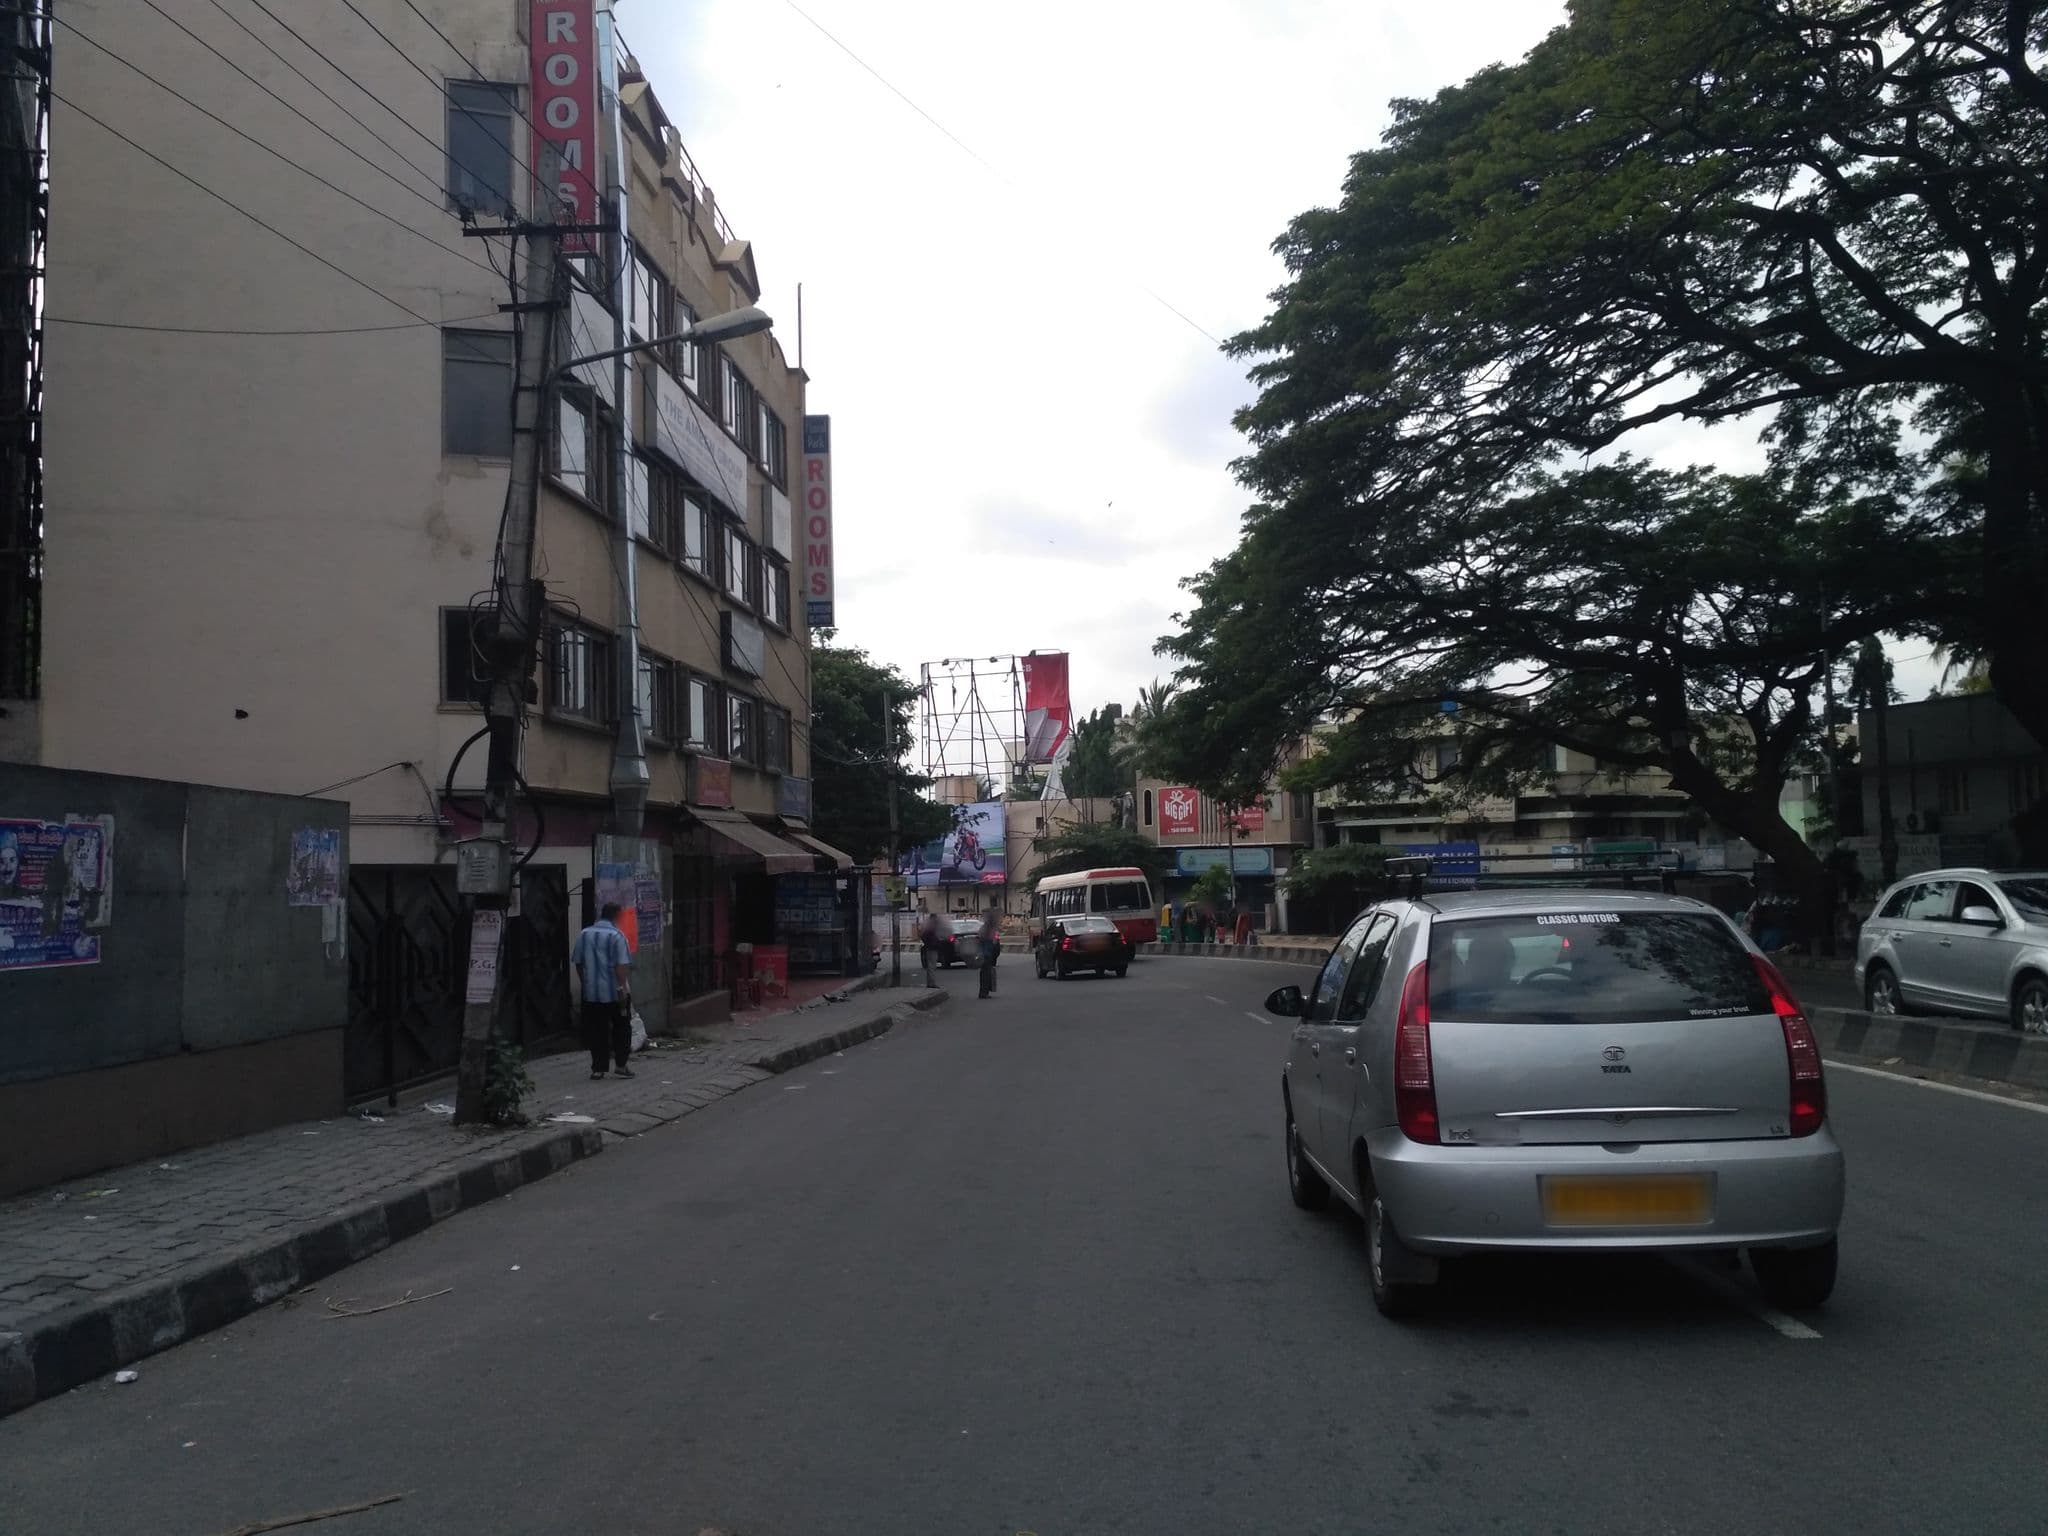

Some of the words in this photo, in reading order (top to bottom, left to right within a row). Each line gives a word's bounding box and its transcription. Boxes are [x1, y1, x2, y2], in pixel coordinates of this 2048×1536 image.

[664, 395, 684, 426] THE
[808, 459, 828, 596] ROOMS
[1165, 800, 1178, 820] BIG
[1178, 798, 1194, 821] GIFT
[1537, 915, 1577, 925] CLASSIC
[1578, 914, 1620, 924] MOTORS
[470, 959, 495, 969] P.G.
[1690, 1008, 1718, 1016] Winning
[1718, 1007, 1732, 1016] your
[1733, 1005, 1750, 1013] trust
[1601, 1065, 1631, 1074] TATA
